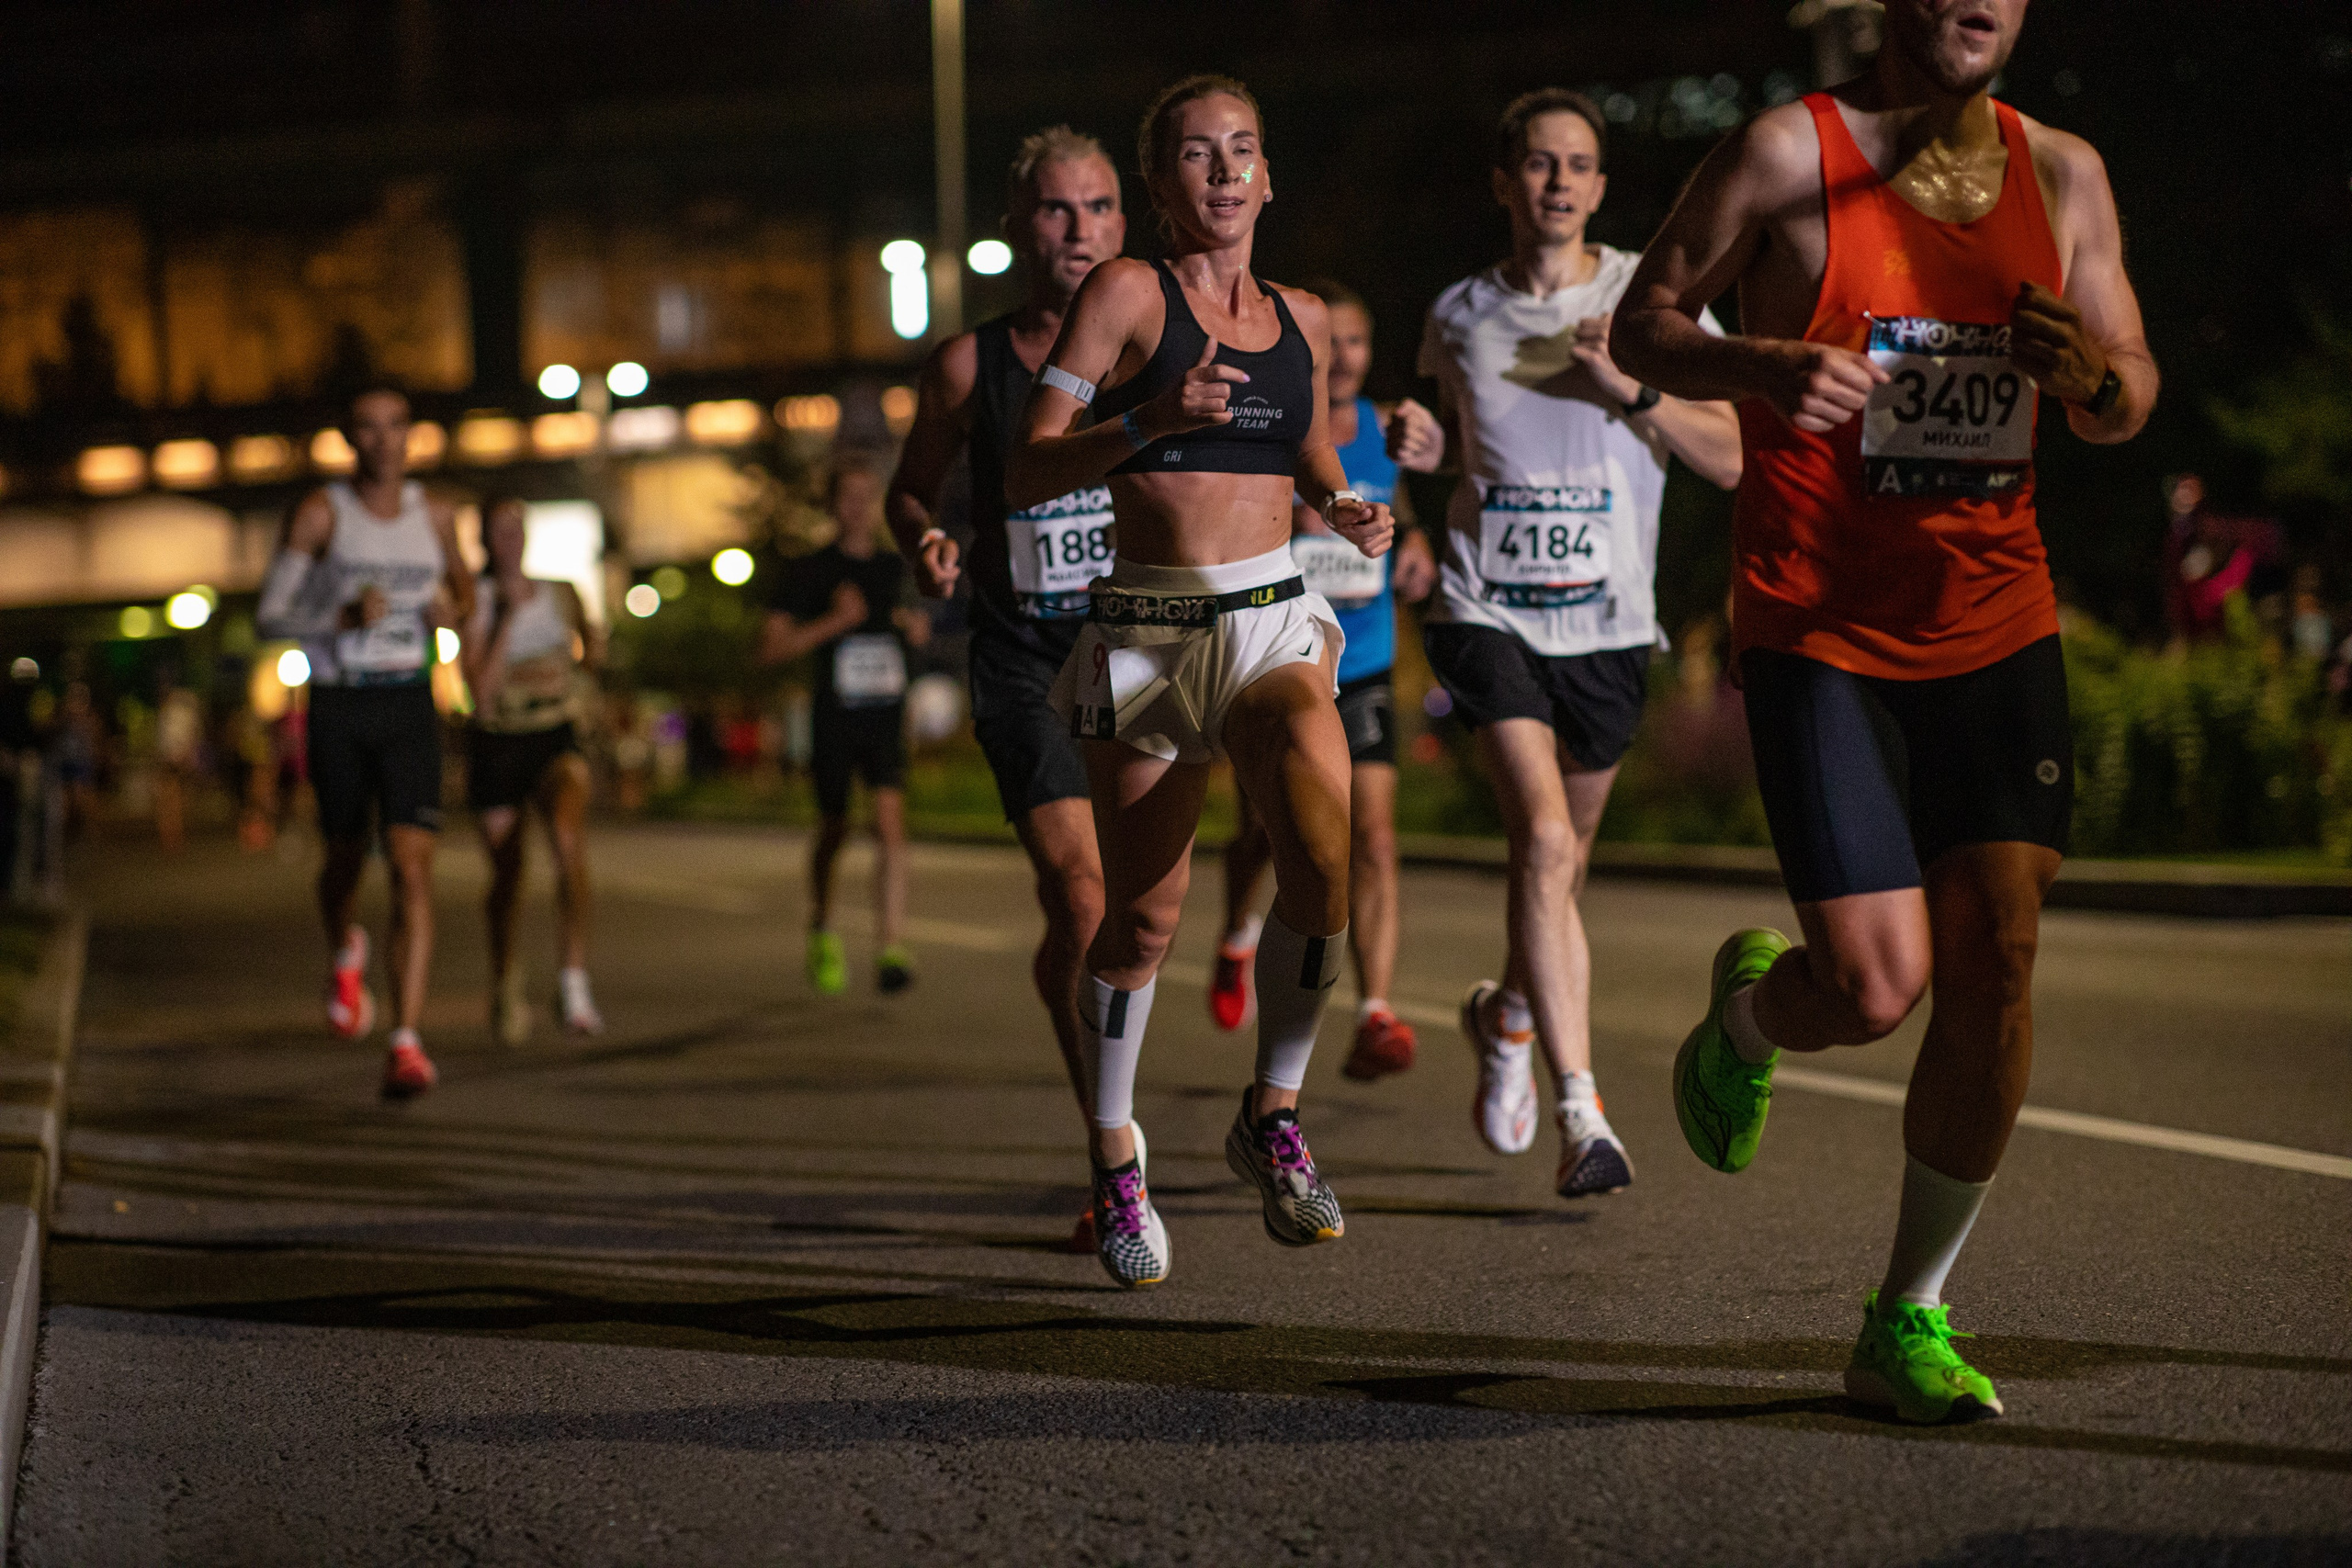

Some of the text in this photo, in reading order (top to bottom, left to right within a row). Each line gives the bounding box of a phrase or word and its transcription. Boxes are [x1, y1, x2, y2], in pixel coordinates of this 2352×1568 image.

[1893, 368, 2020, 427] 3409
[1227, 406, 1283, 419] RUNNING
[1237, 419, 1269, 430] TEAM
[1922, 430, 1991, 449] МИХАИЛ
[1498, 522, 1594, 559] 4184
[1083, 705, 1093, 729] A
